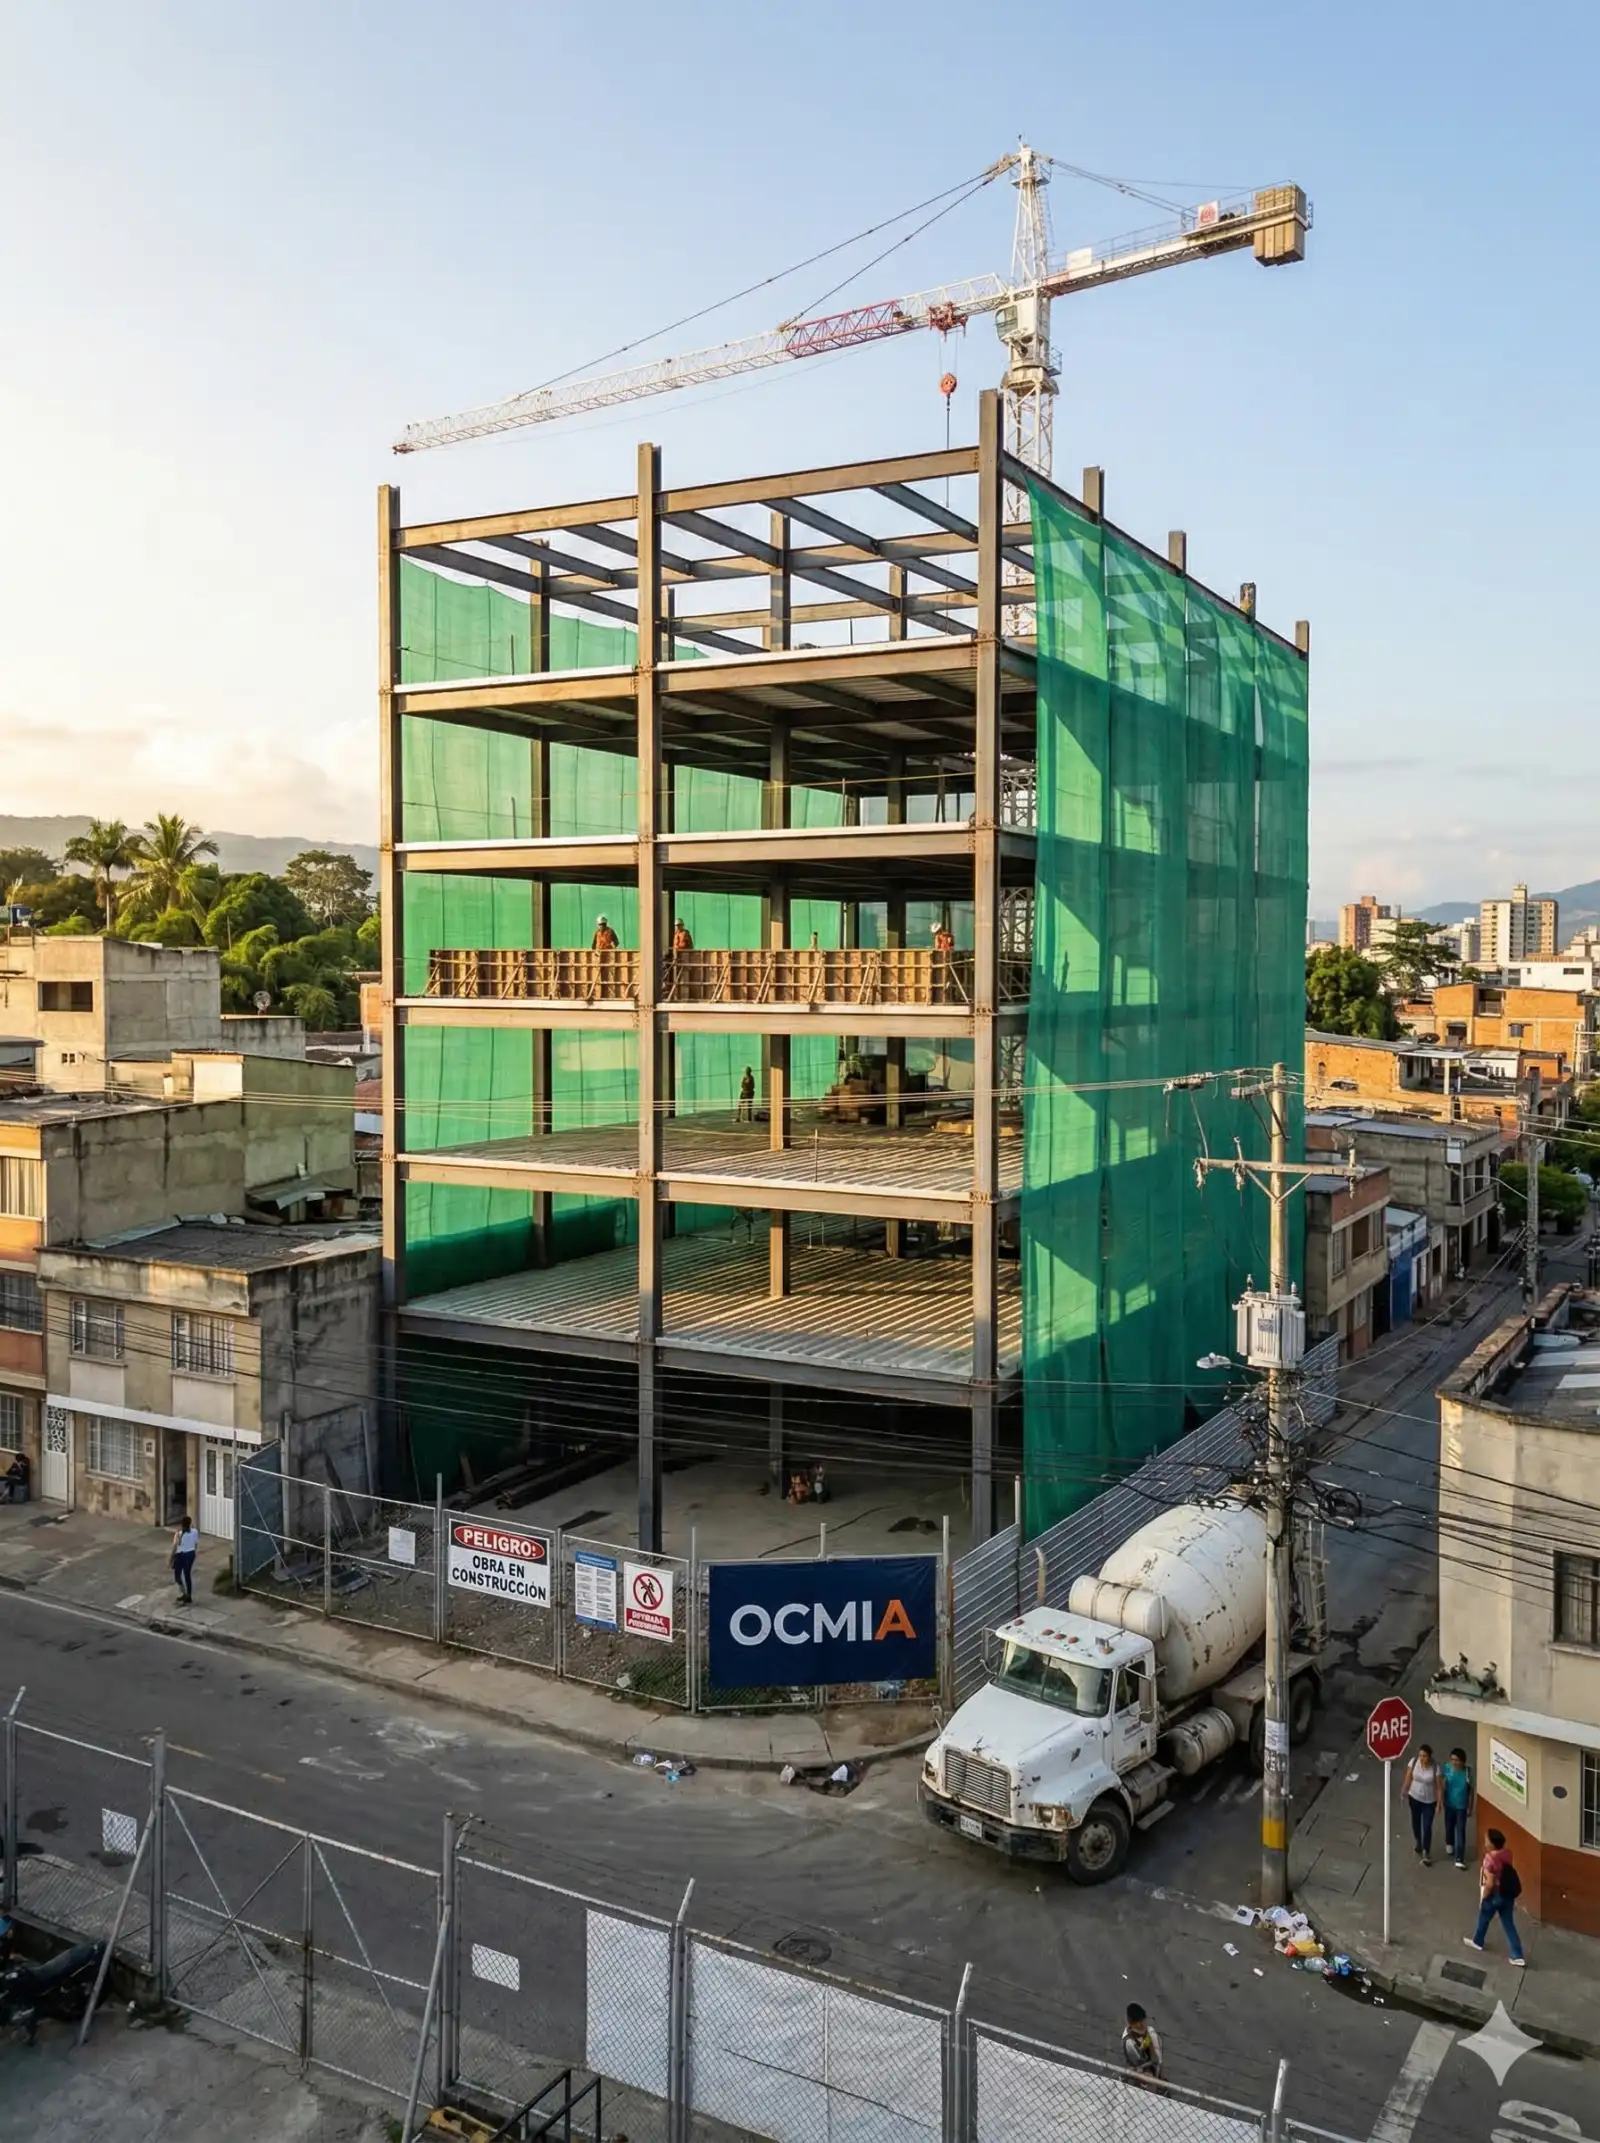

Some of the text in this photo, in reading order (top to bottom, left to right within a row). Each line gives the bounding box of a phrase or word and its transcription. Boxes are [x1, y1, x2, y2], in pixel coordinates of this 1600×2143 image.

[472, 1555, 525, 1578] OBRA EN
[452, 1567, 546, 1600] CONSTRUCCIÓN
[729, 1599, 917, 1646] OCMIA
[1371, 1715, 1409, 1743] PARE
